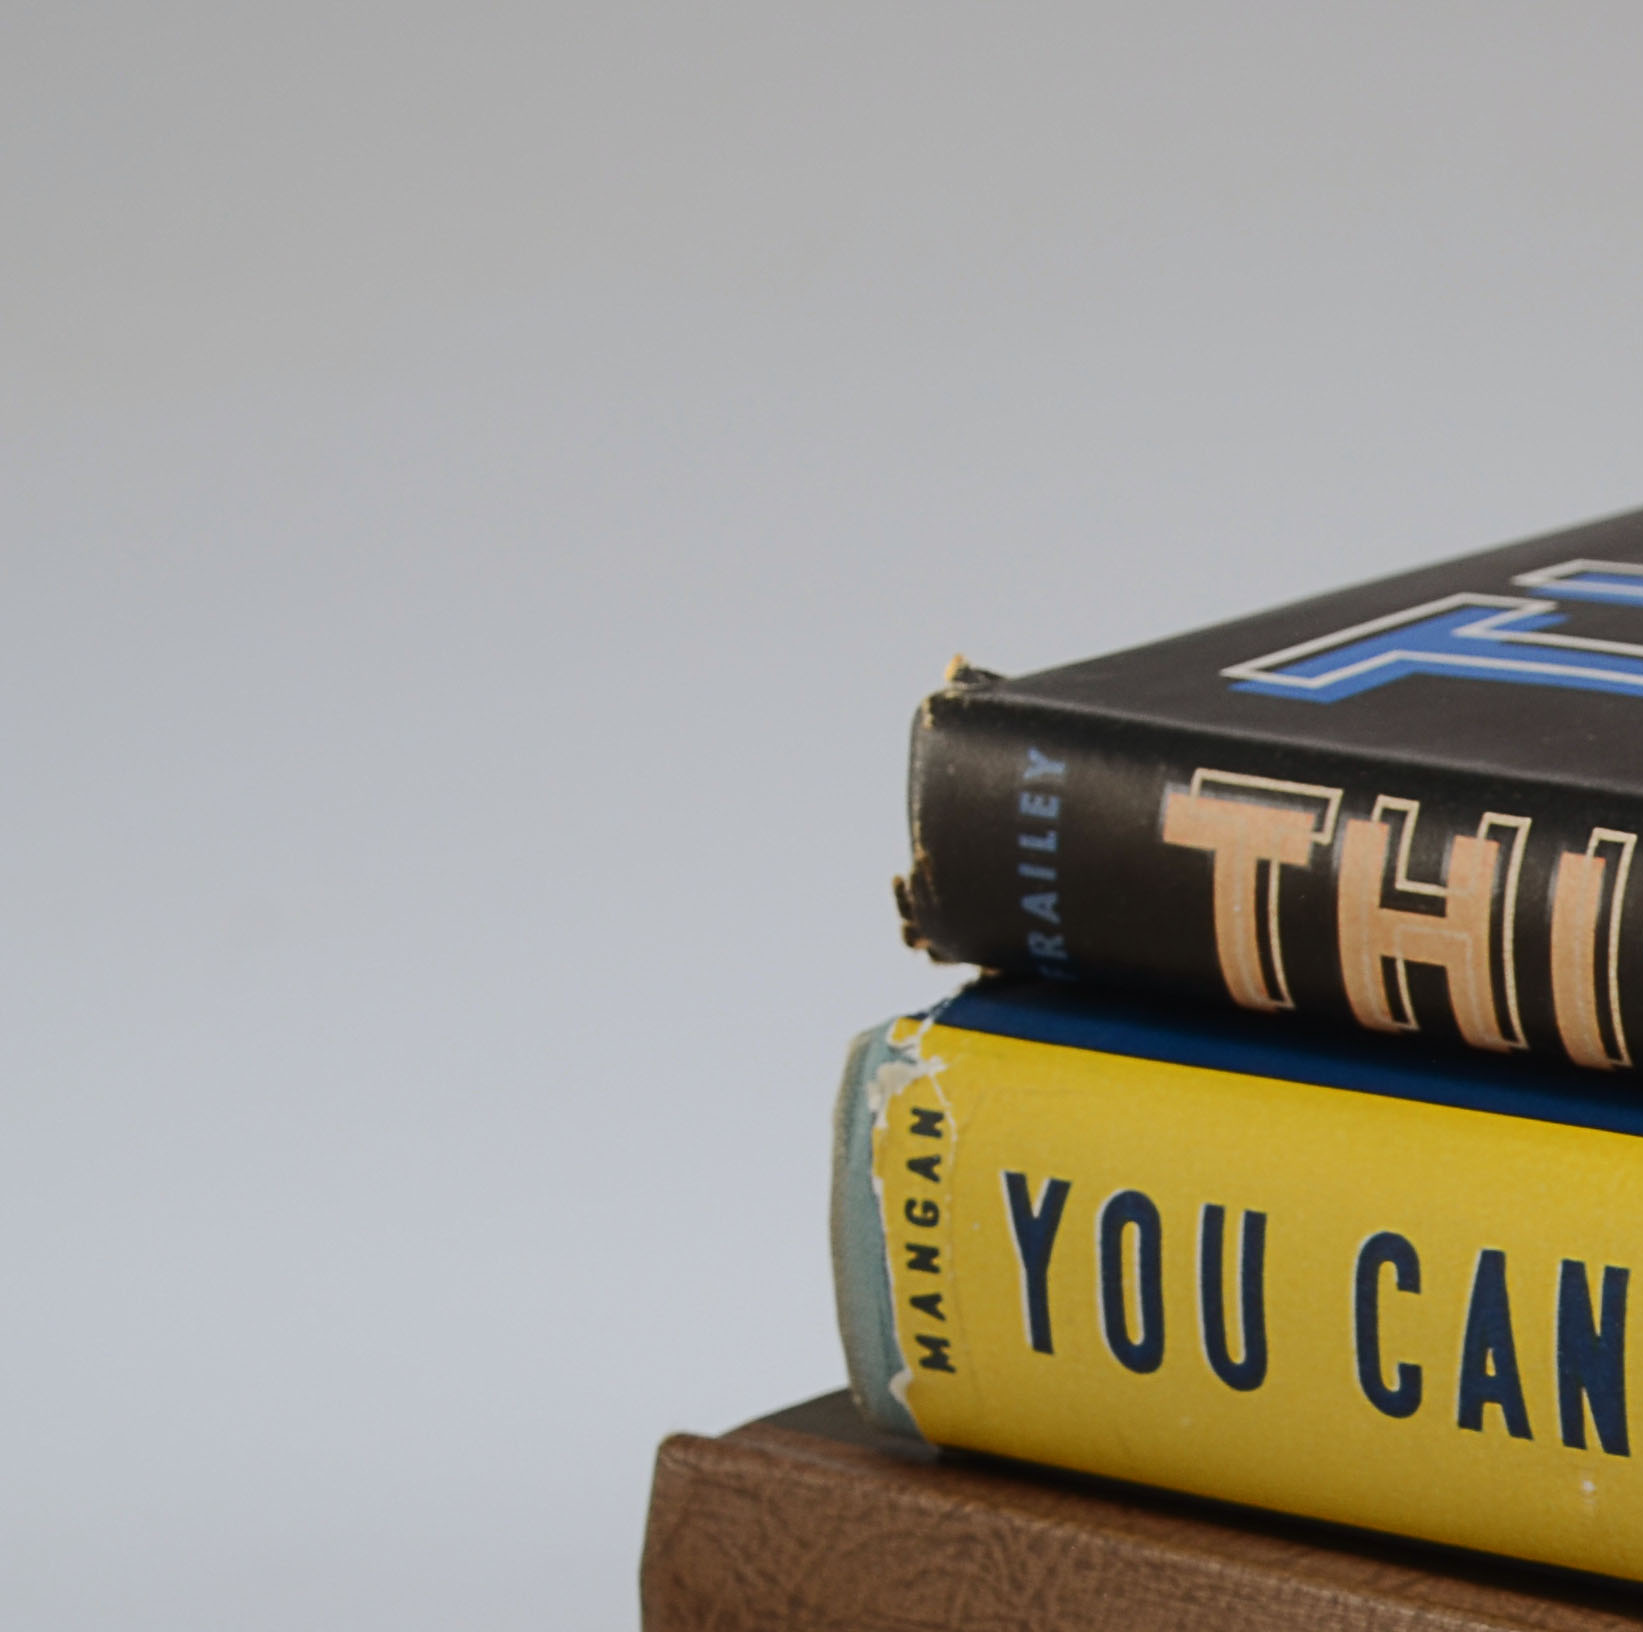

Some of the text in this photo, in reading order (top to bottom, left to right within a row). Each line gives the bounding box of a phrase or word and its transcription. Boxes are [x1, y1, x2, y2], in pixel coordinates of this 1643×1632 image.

[904, 1105, 957, 1374] MANGAN
[1002, 1168, 1268, 1392] YOU
[1354, 1230, 1631, 1459] CAN
